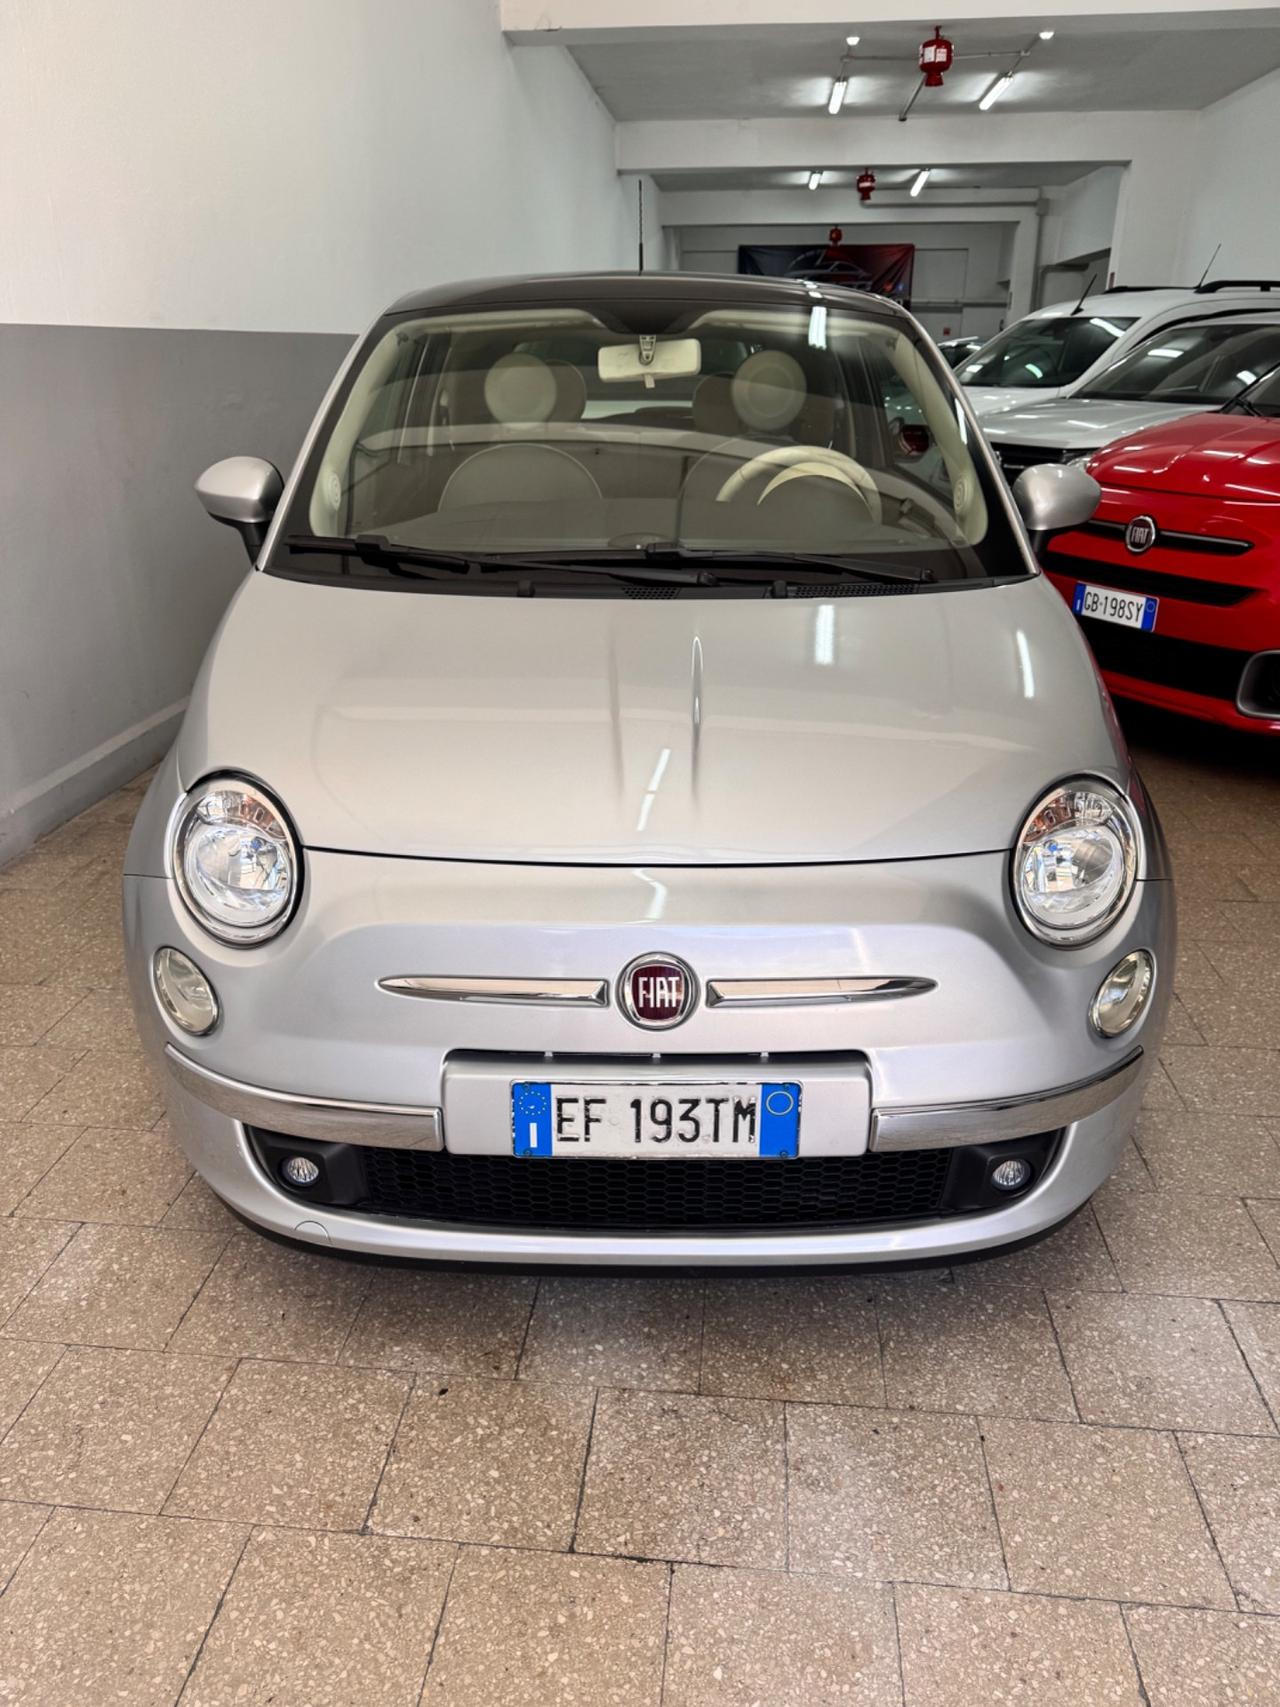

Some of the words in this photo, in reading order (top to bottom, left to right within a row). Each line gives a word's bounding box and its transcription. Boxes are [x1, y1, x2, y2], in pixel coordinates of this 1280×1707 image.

[1131, 527, 1149, 544] FIAT
[638, 976, 680, 1008] FIAT
[529, 1122, 538, 1148] I
[556, 1097, 607, 1143] EF
[630, 1097, 757, 1144] 193TM
